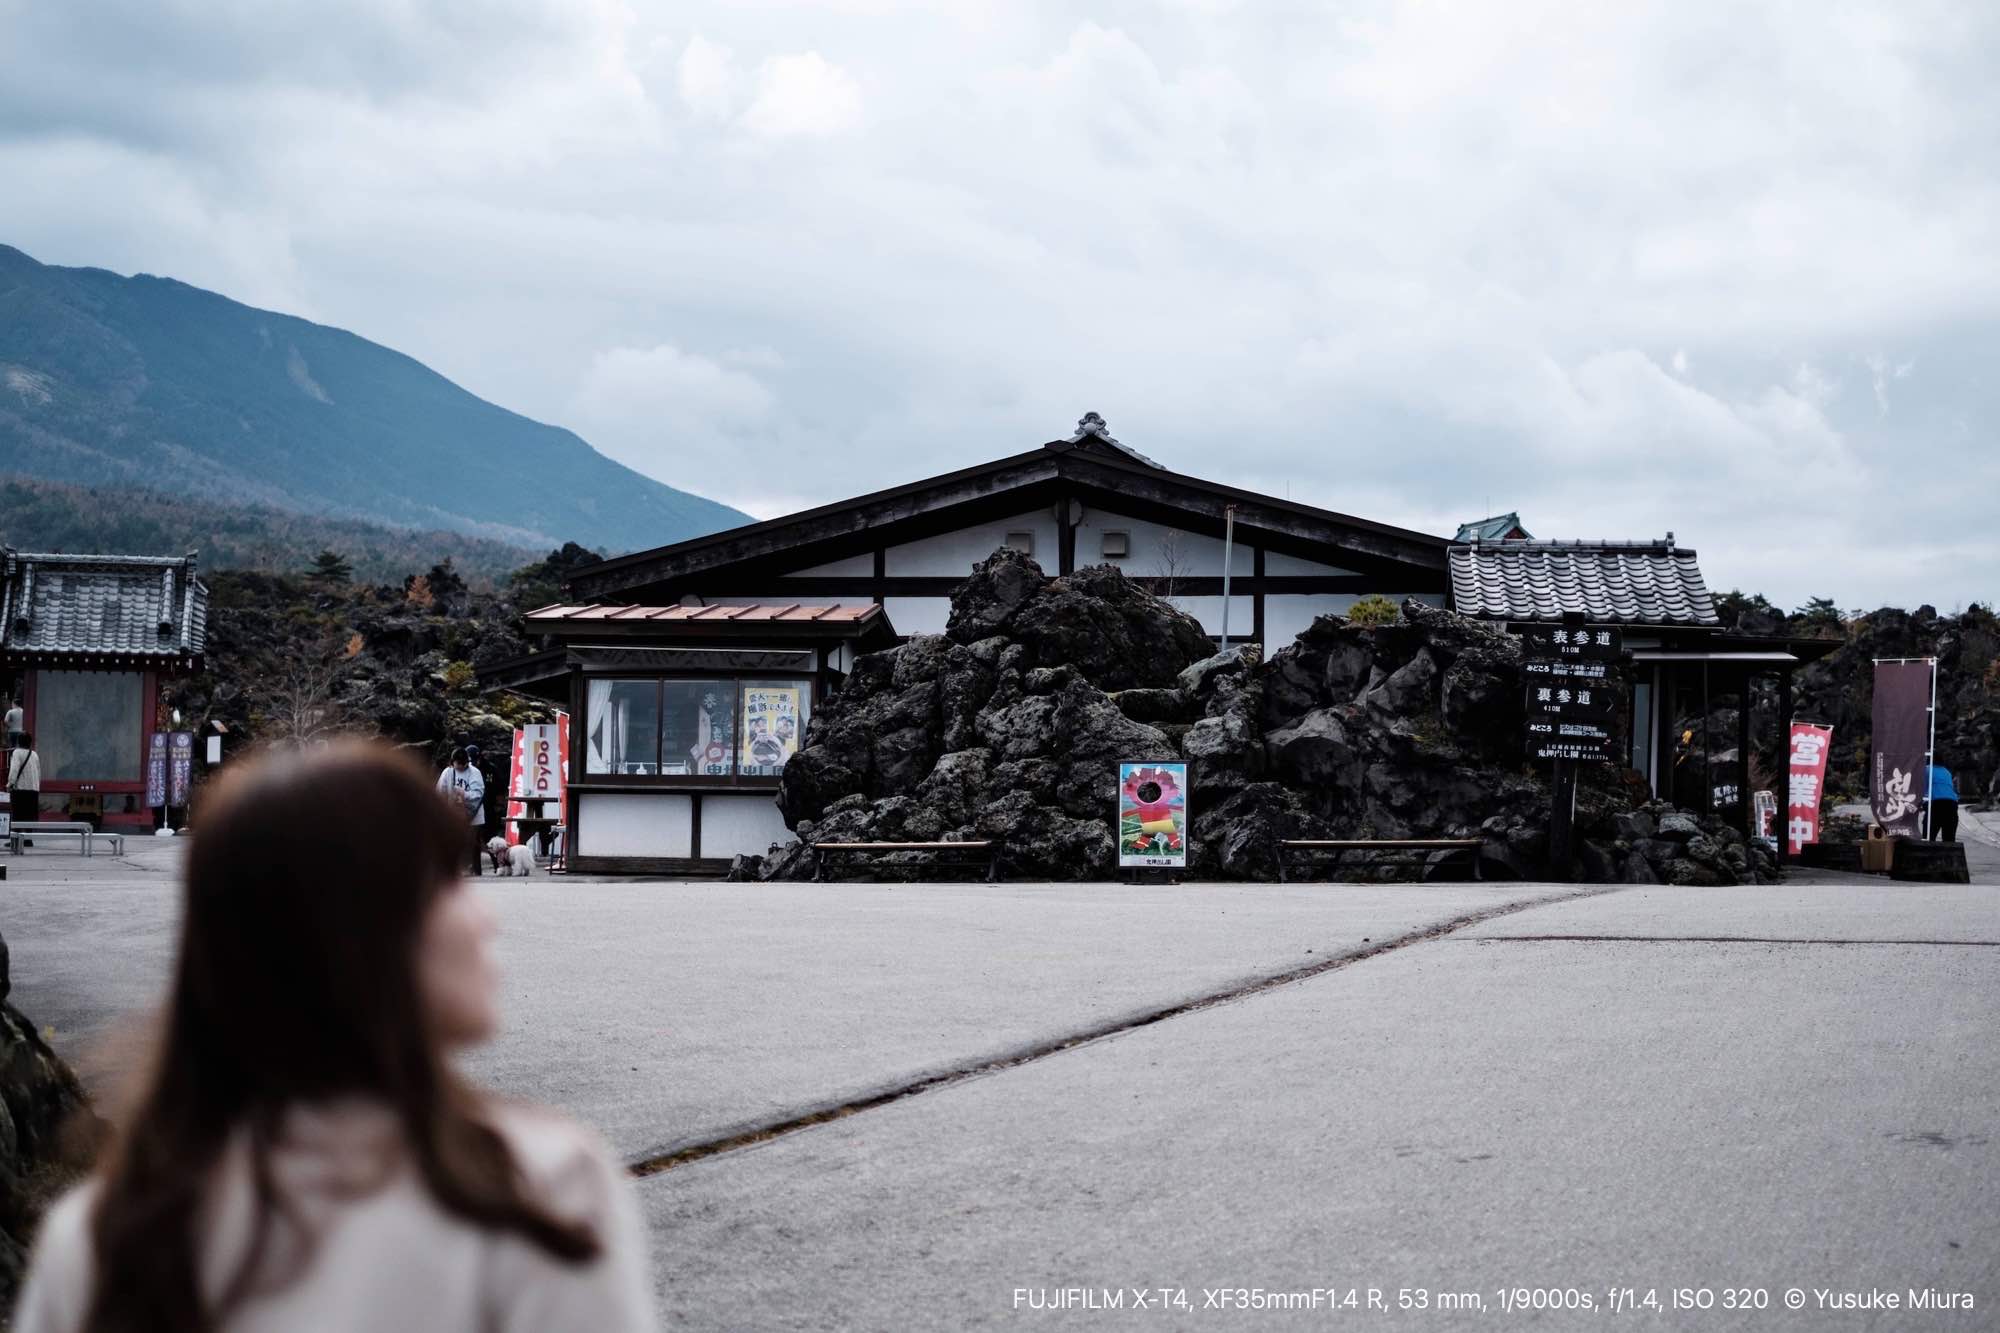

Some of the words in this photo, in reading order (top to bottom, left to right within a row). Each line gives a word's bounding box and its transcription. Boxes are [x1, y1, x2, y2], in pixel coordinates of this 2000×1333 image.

[1553, 629, 1611, 645] 表参道
[1526, 664, 1550, 673] みどころ
[1537, 687, 1592, 705] 裏参道
[1529, 724, 1553, 733] みどころ
[537, 740, 552, 790] DyDo
[1789, 732, 1826, 850] 営業中
